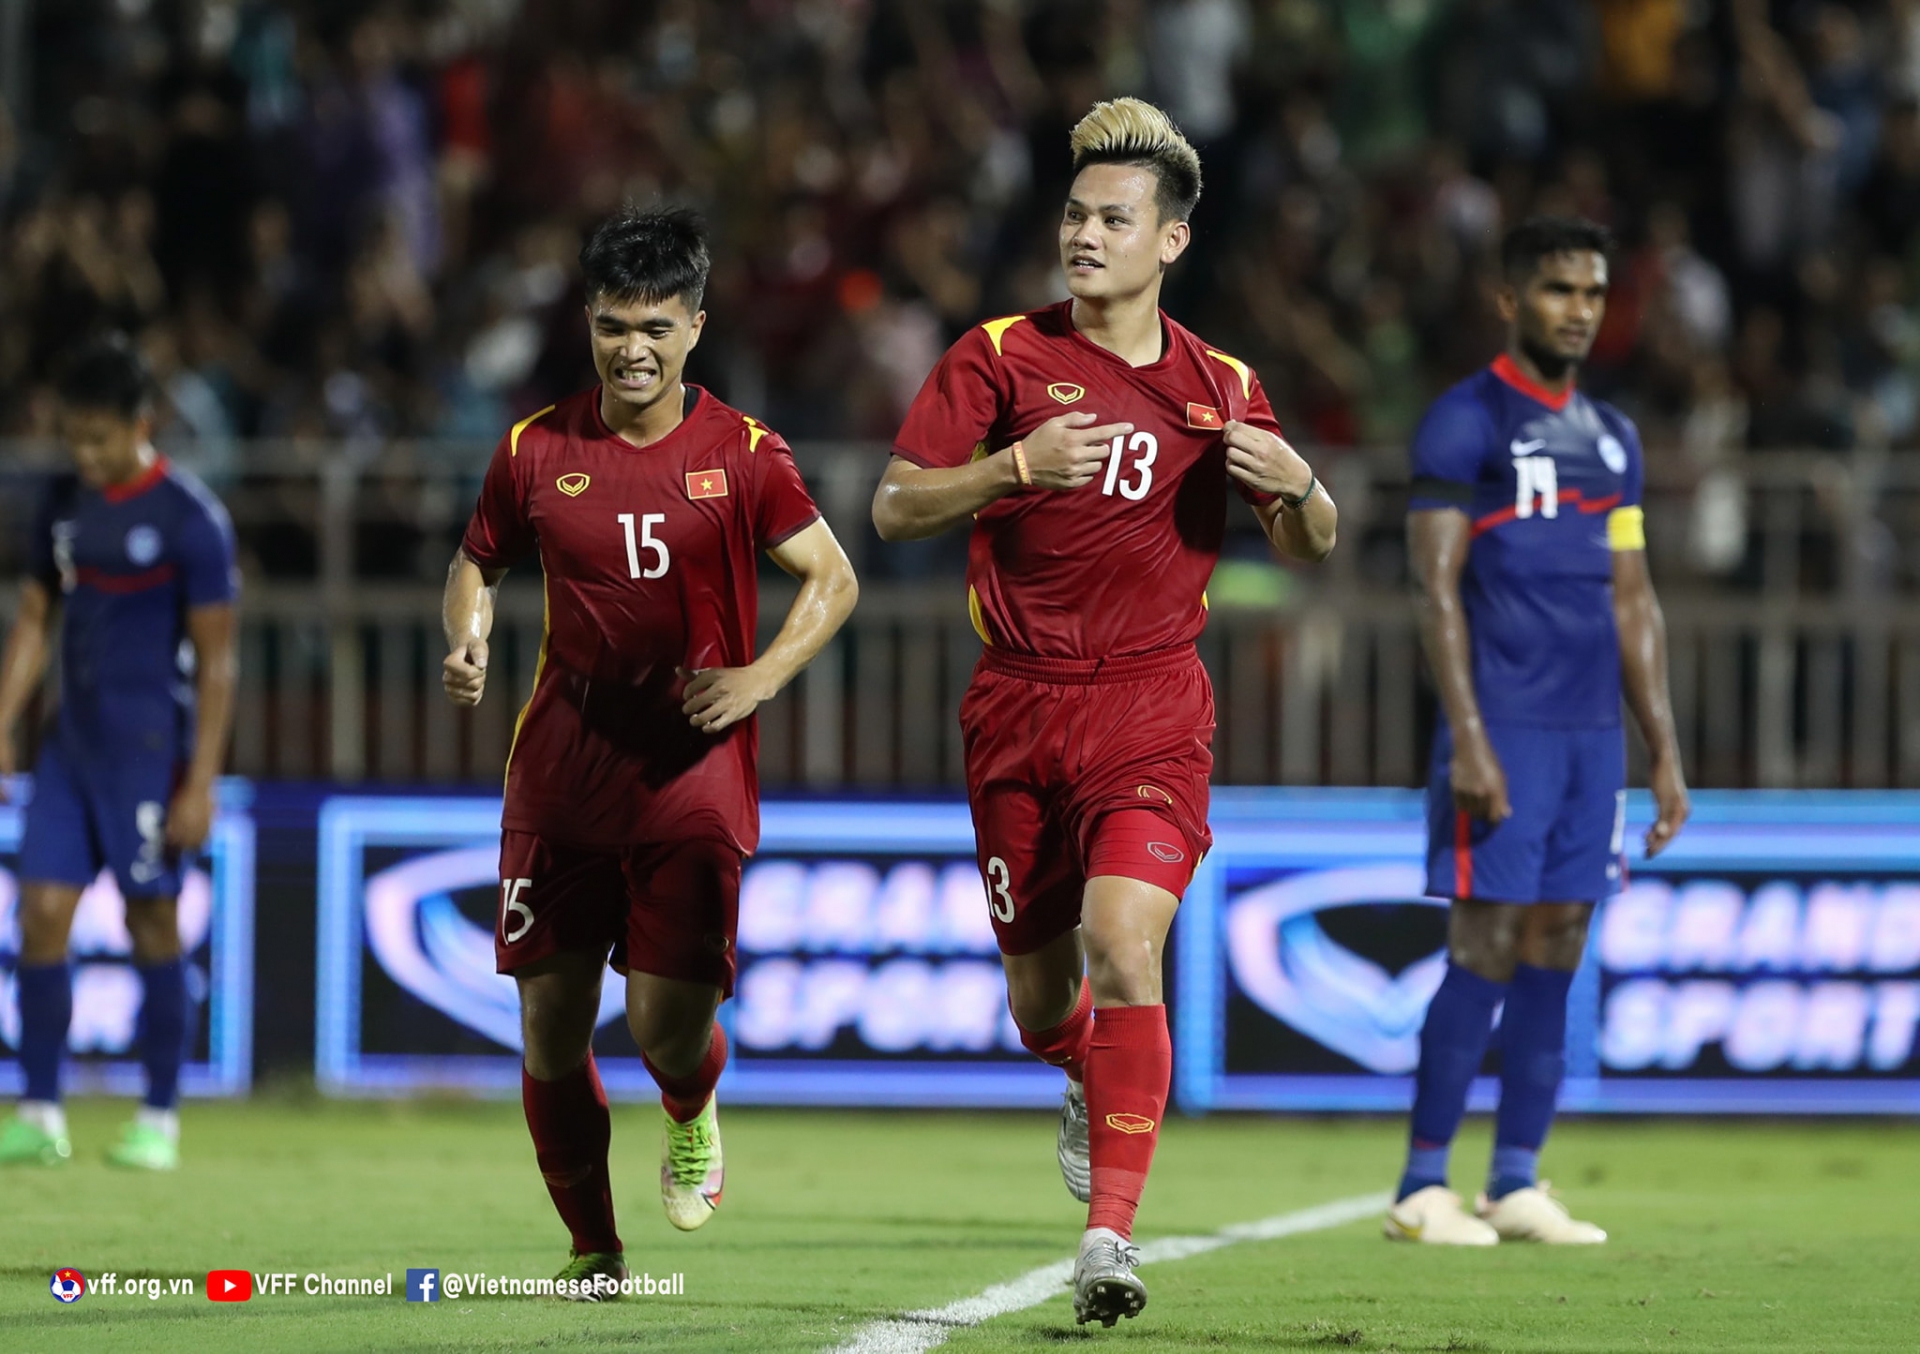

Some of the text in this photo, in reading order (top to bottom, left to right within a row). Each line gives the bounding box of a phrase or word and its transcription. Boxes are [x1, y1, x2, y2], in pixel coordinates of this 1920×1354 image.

[1101, 430, 1158, 501] 13
[617, 512, 671, 580] 15
[502, 878, 535, 946] 15
